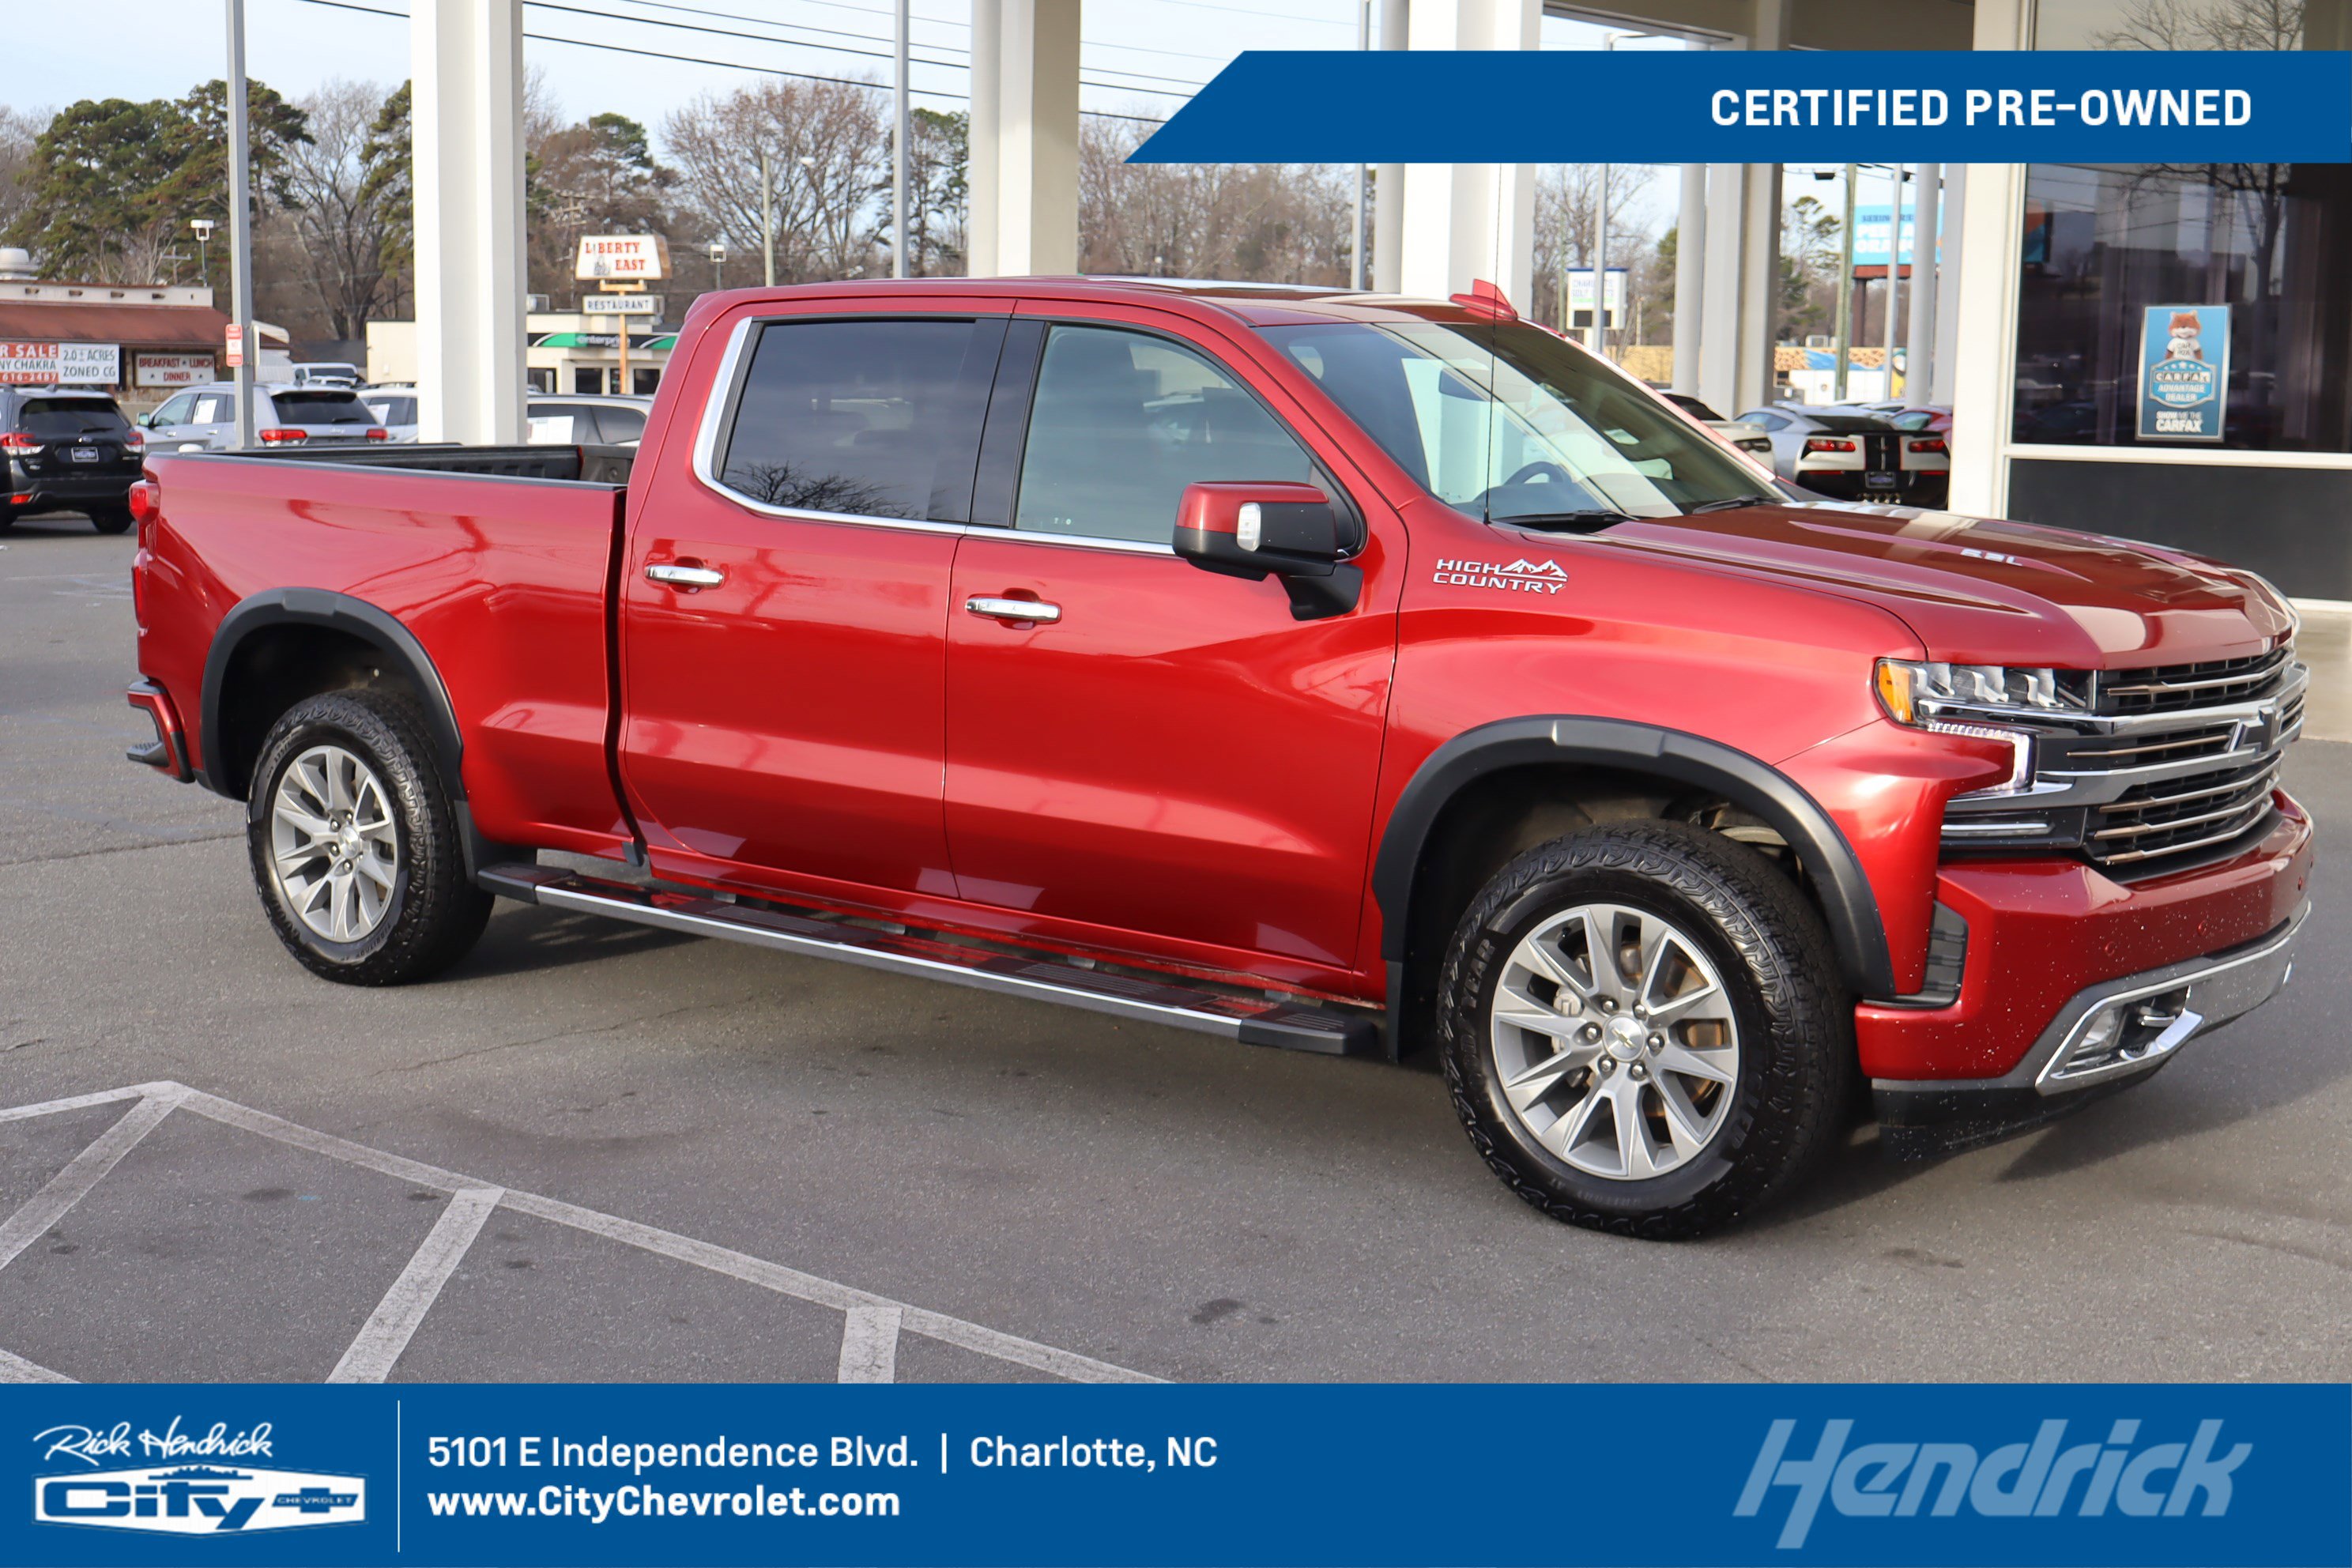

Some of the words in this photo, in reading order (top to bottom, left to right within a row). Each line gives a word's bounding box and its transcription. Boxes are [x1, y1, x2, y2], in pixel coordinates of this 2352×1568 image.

[585, 242, 640, 254] LIBERTY
[615, 259, 646, 270] EAST
[587, 300, 649, 311] RESTAURANT
[16, 344, 58, 358] SALE
[62, 349, 77, 361] 2.0
[87, 349, 115, 361] ACRES
[14, 359, 56, 371] CHAKRA
[139, 357, 180, 368] BREAKFAST
[190, 357, 214, 368] LUNCH
[62, 365, 100, 377] ZONED
[103, 365, 116, 377] CG
[163, 371, 191, 383] DINNER
[2154, 372, 2211, 383] CARFAX
[2158, 384, 2205, 393] ADVANTAGE
[2156, 411, 2177, 420] SHOW
[2156, 420, 2203, 432] CARFAX
[1436, 559, 1502, 575] HIGH
[1432, 572, 1566, 594] COUNTRY
